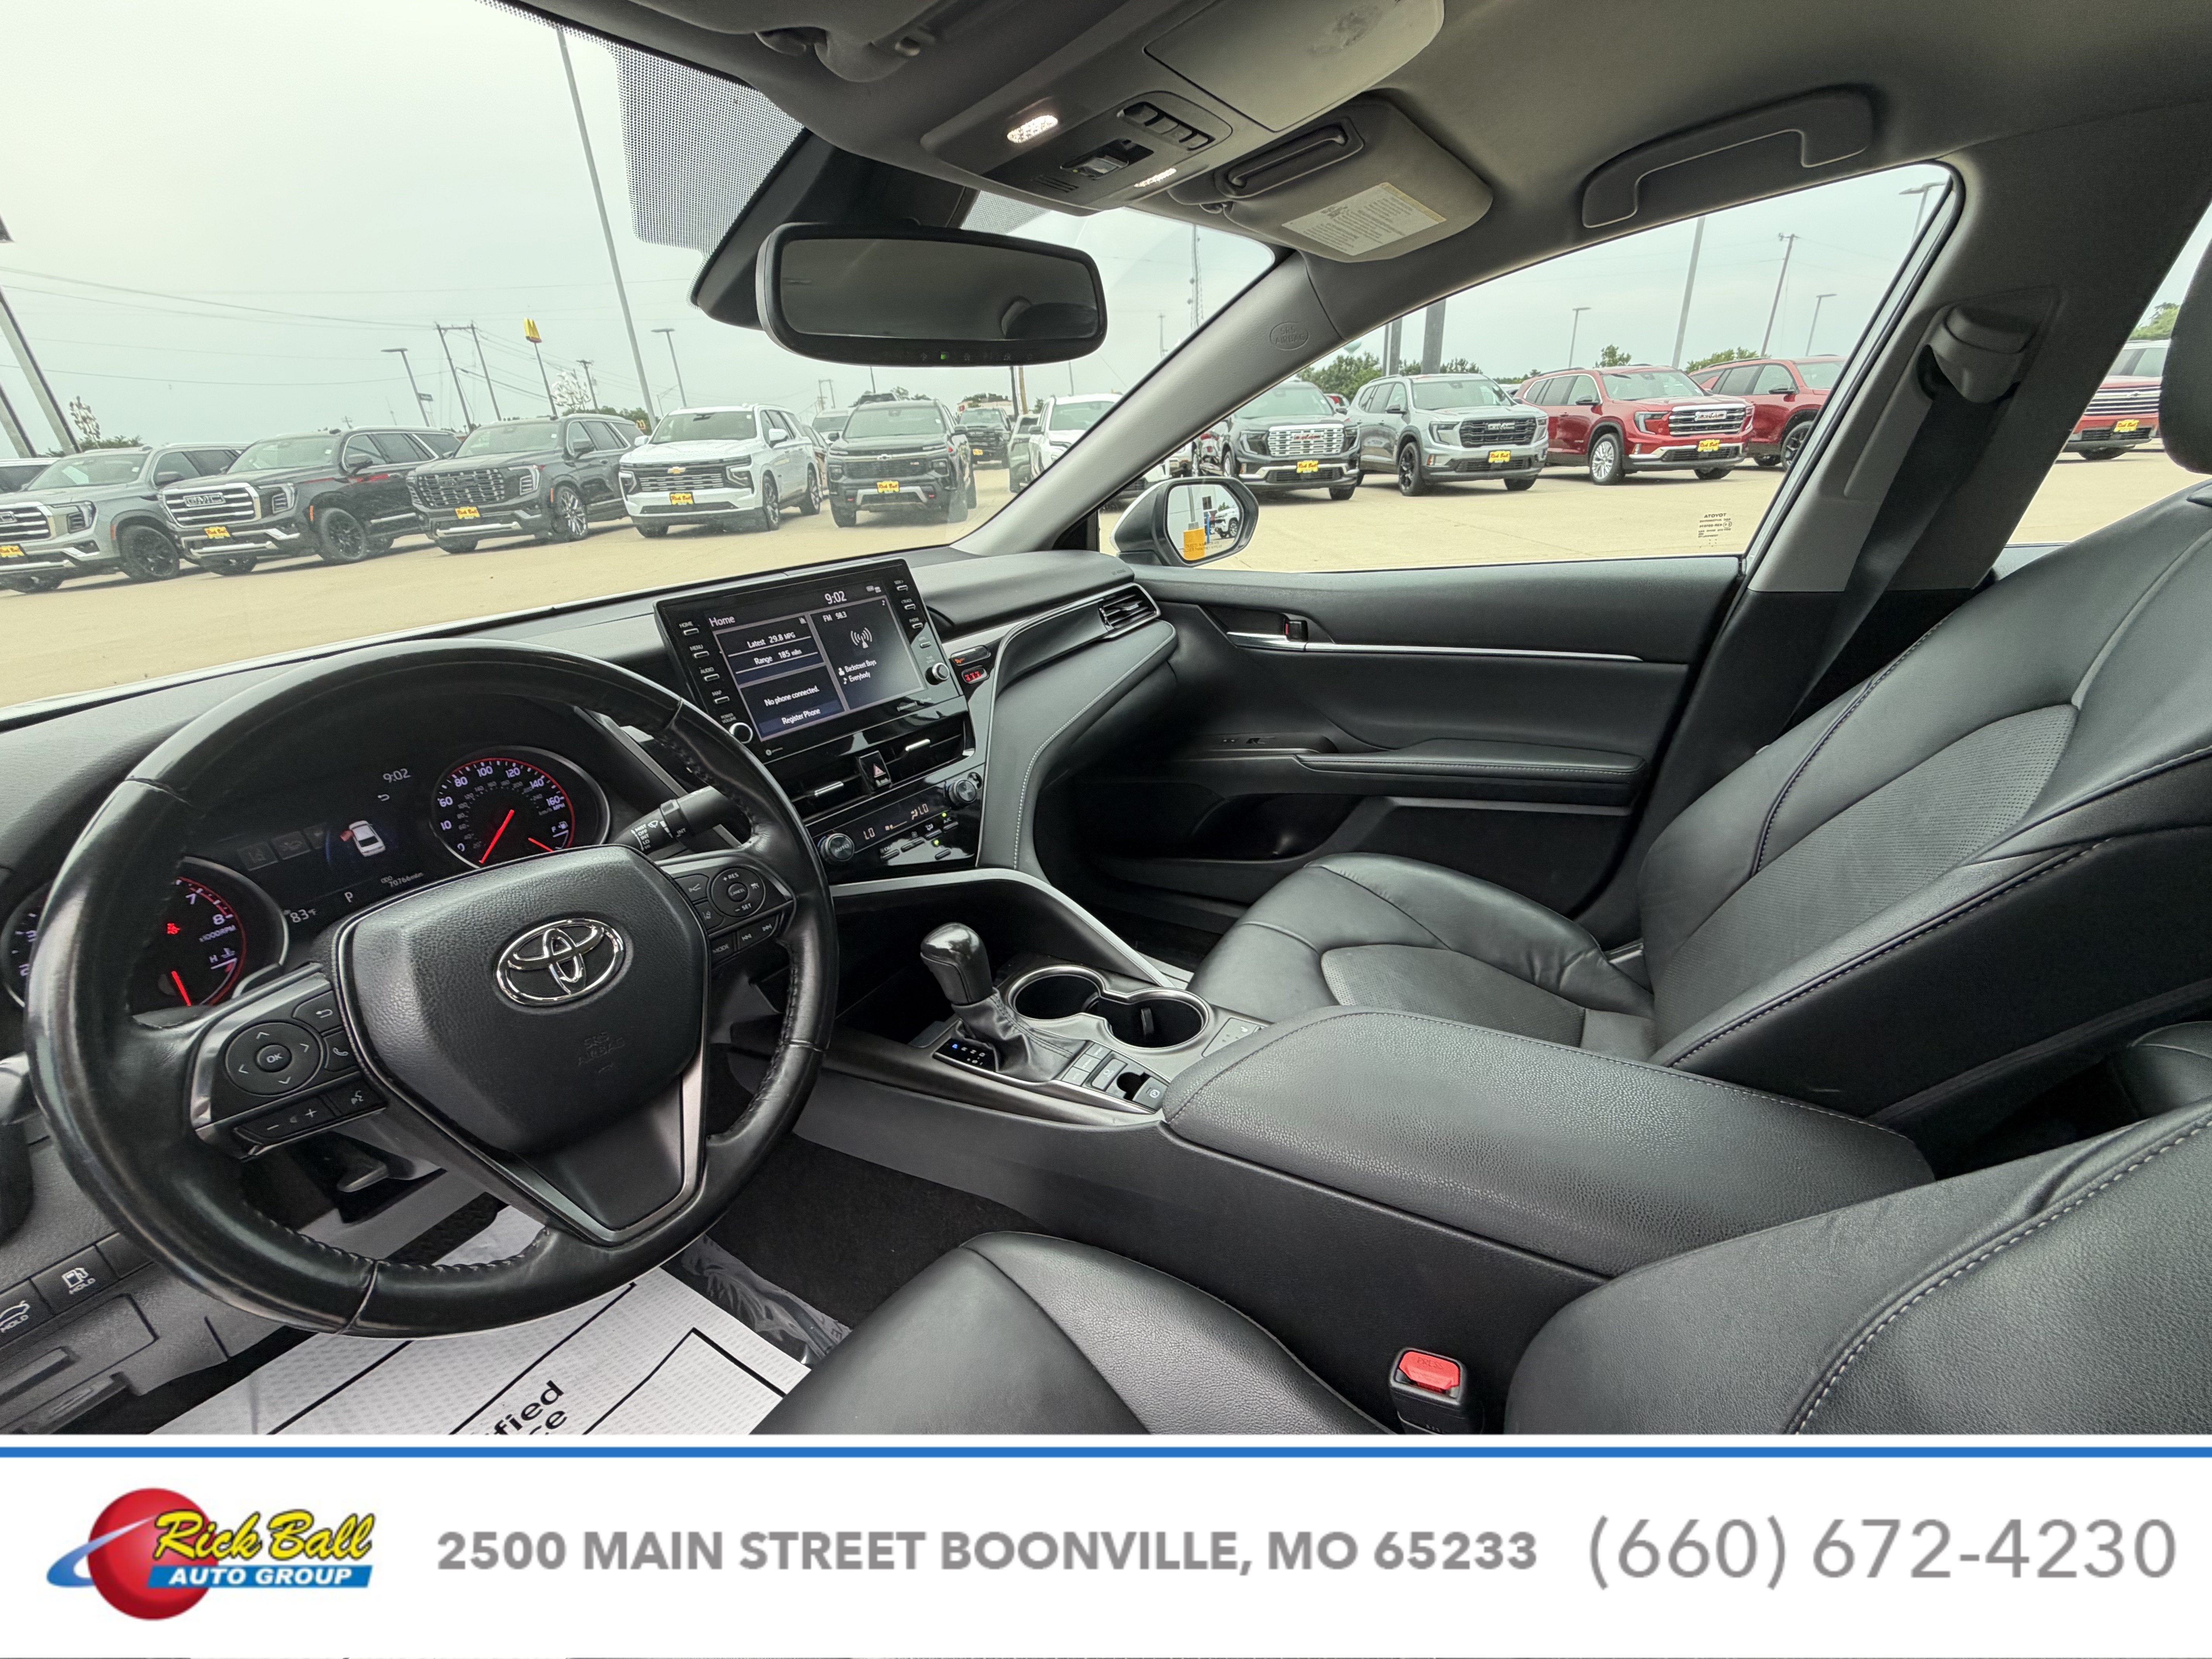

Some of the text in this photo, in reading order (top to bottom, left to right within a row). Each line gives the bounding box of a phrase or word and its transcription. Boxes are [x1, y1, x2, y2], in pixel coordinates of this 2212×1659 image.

[824, 591, 847, 604] 9:02
[709, 616, 735, 627] Home
[747, 639, 766, 648] Latest
[768, 634, 784, 643] 29.8
[754, 656, 773, 665] Range
[778, 650, 790, 659] 185
[844, 662, 866, 672] Backstreet
[848, 671, 871, 682] Everybody
[775, 694, 792, 704] phone
[792, 685, 819, 699] connected.
[781, 709, 821, 725] Register Phone
[383, 768, 410, 783] 9:02
[477, 766, 493, 777] 100
[505, 767, 520, 778] 120
[454, 776, 468, 787] 80
[529, 778, 544, 789] 140
[439, 796, 453, 807] 60
[546, 795, 560, 806] 160
[918, 803, 929, 815] LO
[863, 828, 875, 840] LO
[834, 843, 850, 853] AUTO
[185, 893, 196, 905] 7
[344, 892, 353, 903] P
[213, 914, 225, 925] 8
[26, 930, 37, 942] 3
[209, 955, 218, 963] H
[19, 963, 30, 976] 2
[266, 1053, 283, 1063] OK
[69, 1278, 96, 1295] HOLD
[0, 1314, 29, 1333] HOLD
[1417, 1357, 1444, 1369] PRESS
[485, 1380, 564, 1435] fied
